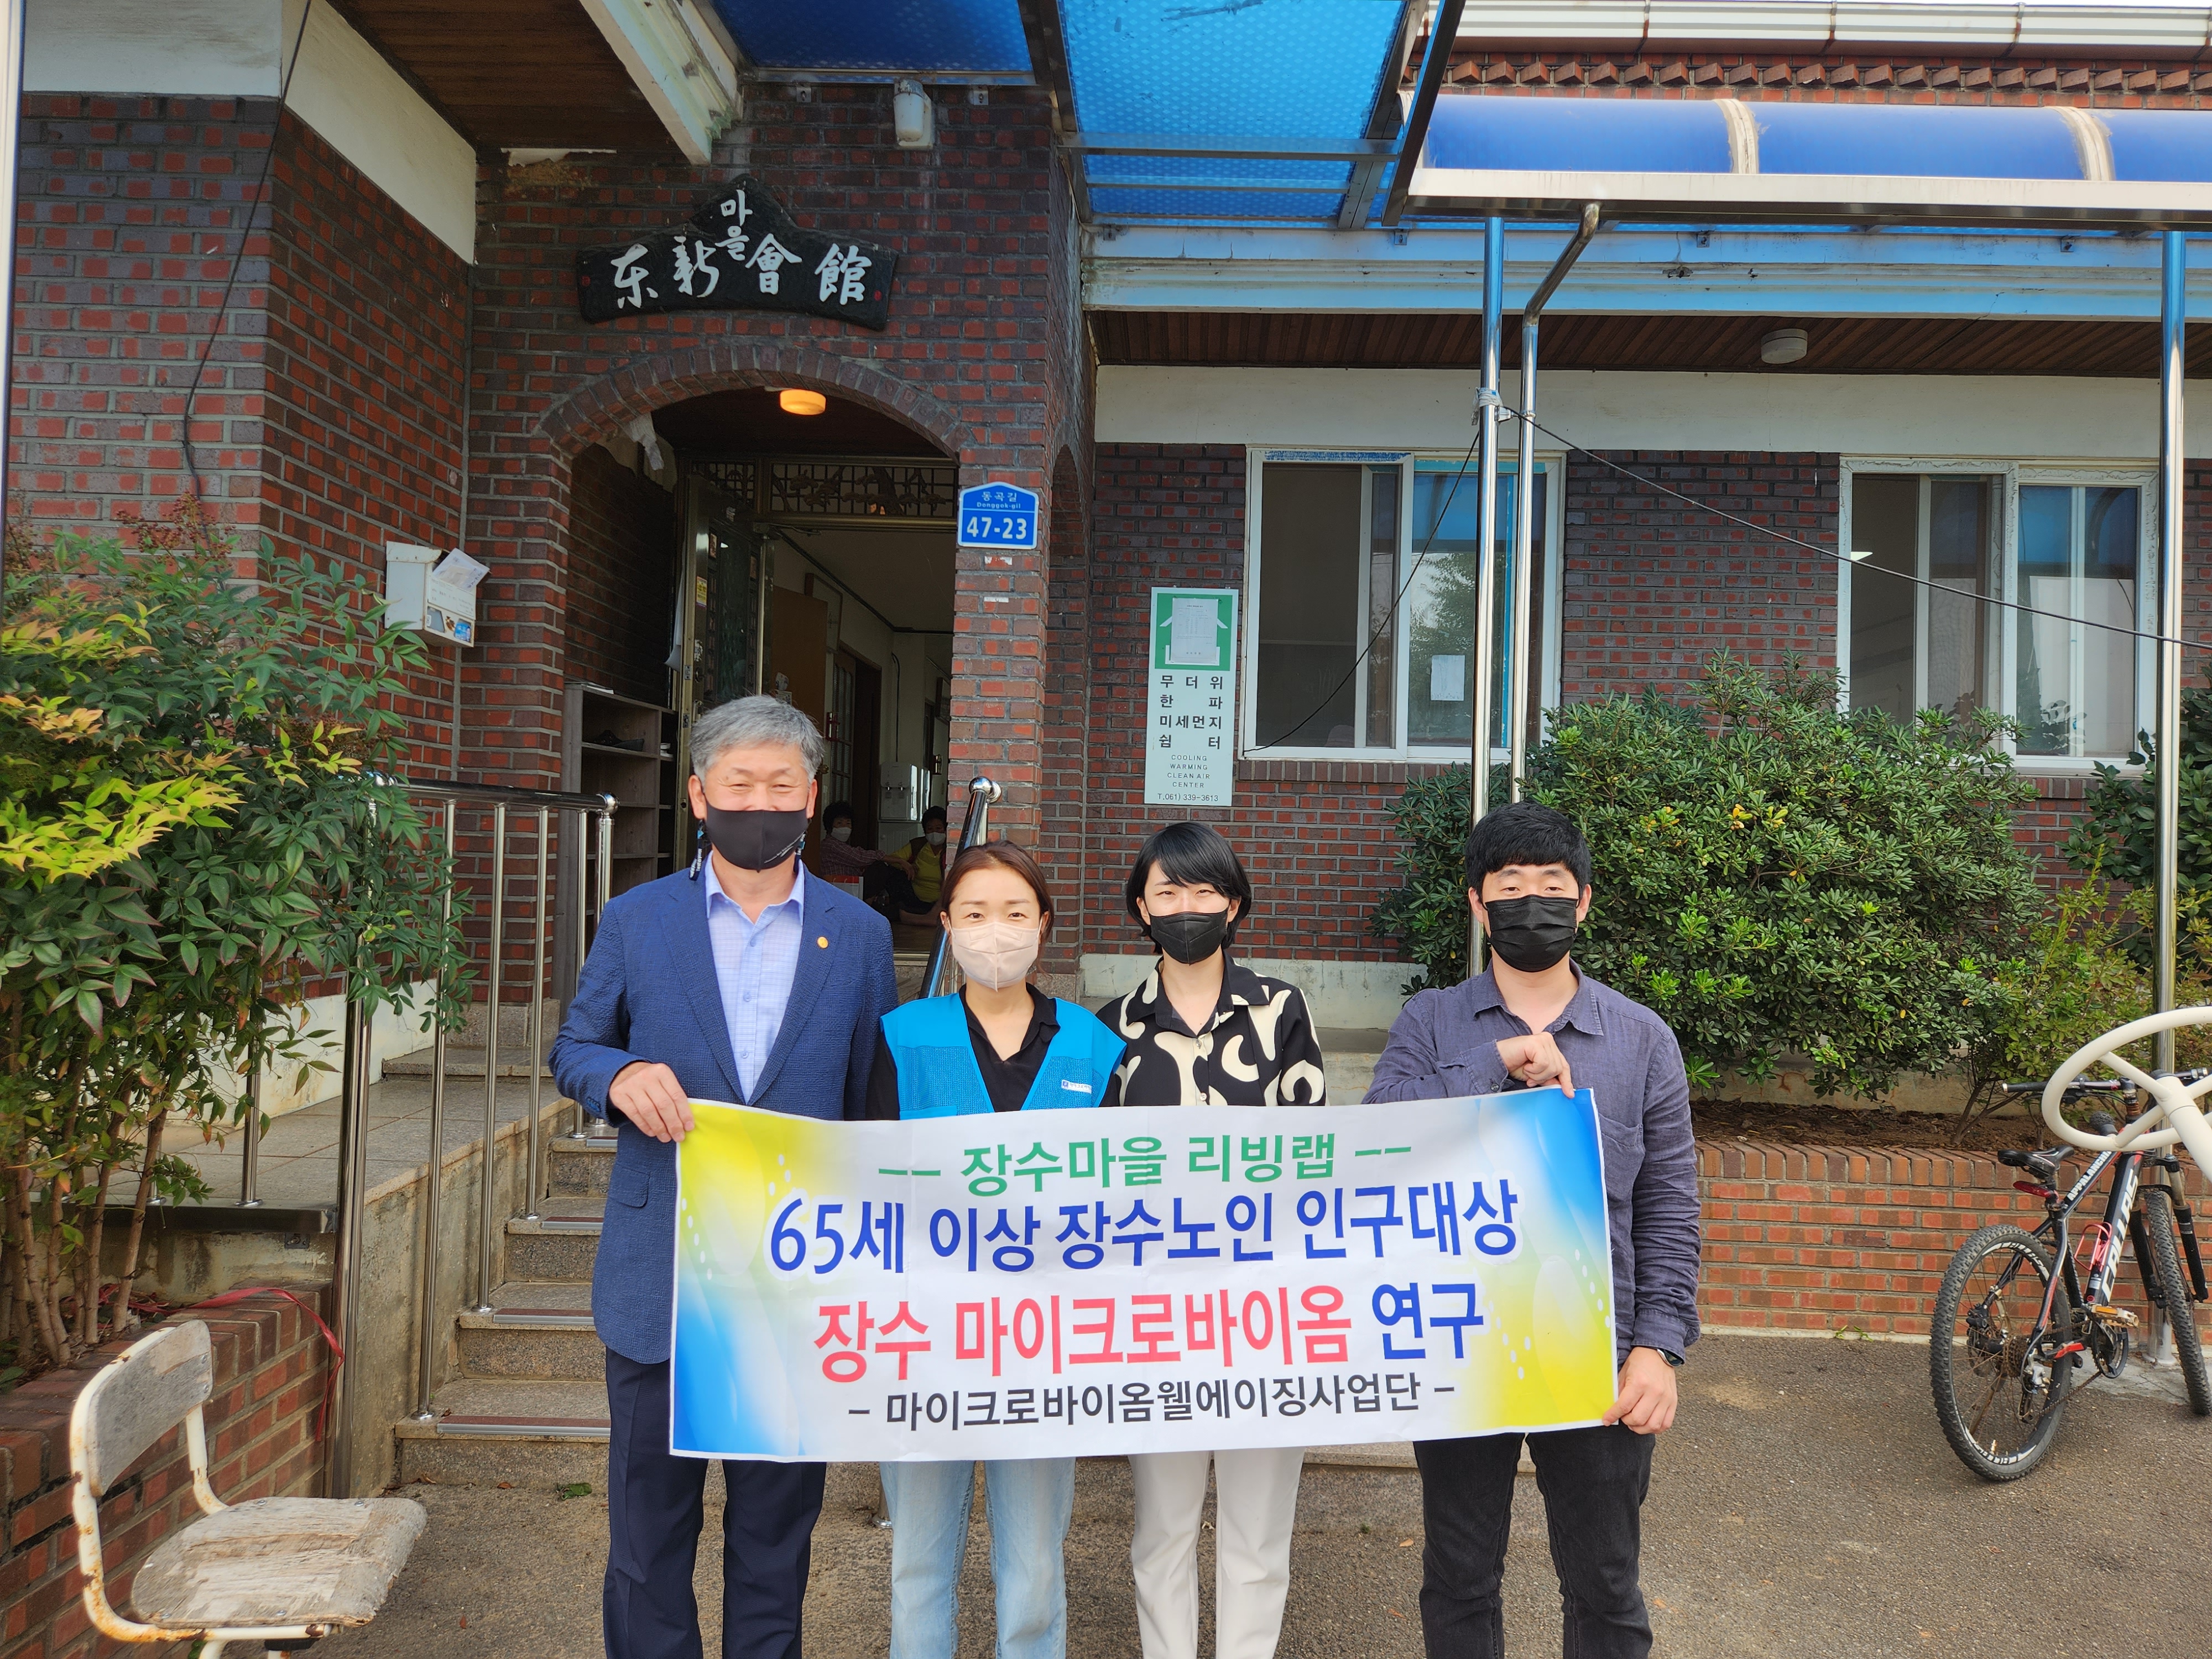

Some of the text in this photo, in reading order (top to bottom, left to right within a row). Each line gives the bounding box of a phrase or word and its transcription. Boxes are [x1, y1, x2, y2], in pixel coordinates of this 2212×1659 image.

[714, 189, 753, 260] 마을
[982, 491, 1017, 502] 동곡길
[967, 517, 1027, 540] 47-23
[1160, 714, 1222, 729] 미세먼지
[1183, 794, 1219, 802] 339-3613
[961, 1133, 1335, 1197] 장수마을 리빙랩
[770, 1179, 1518, 1274] 65세 이상 장수노인 인구대상
[814, 1282, 1484, 1383] 장수 마이크로바이옴 연구
[886, 1373, 1421, 1432] 마이크로바이옴웰에이징사업단
